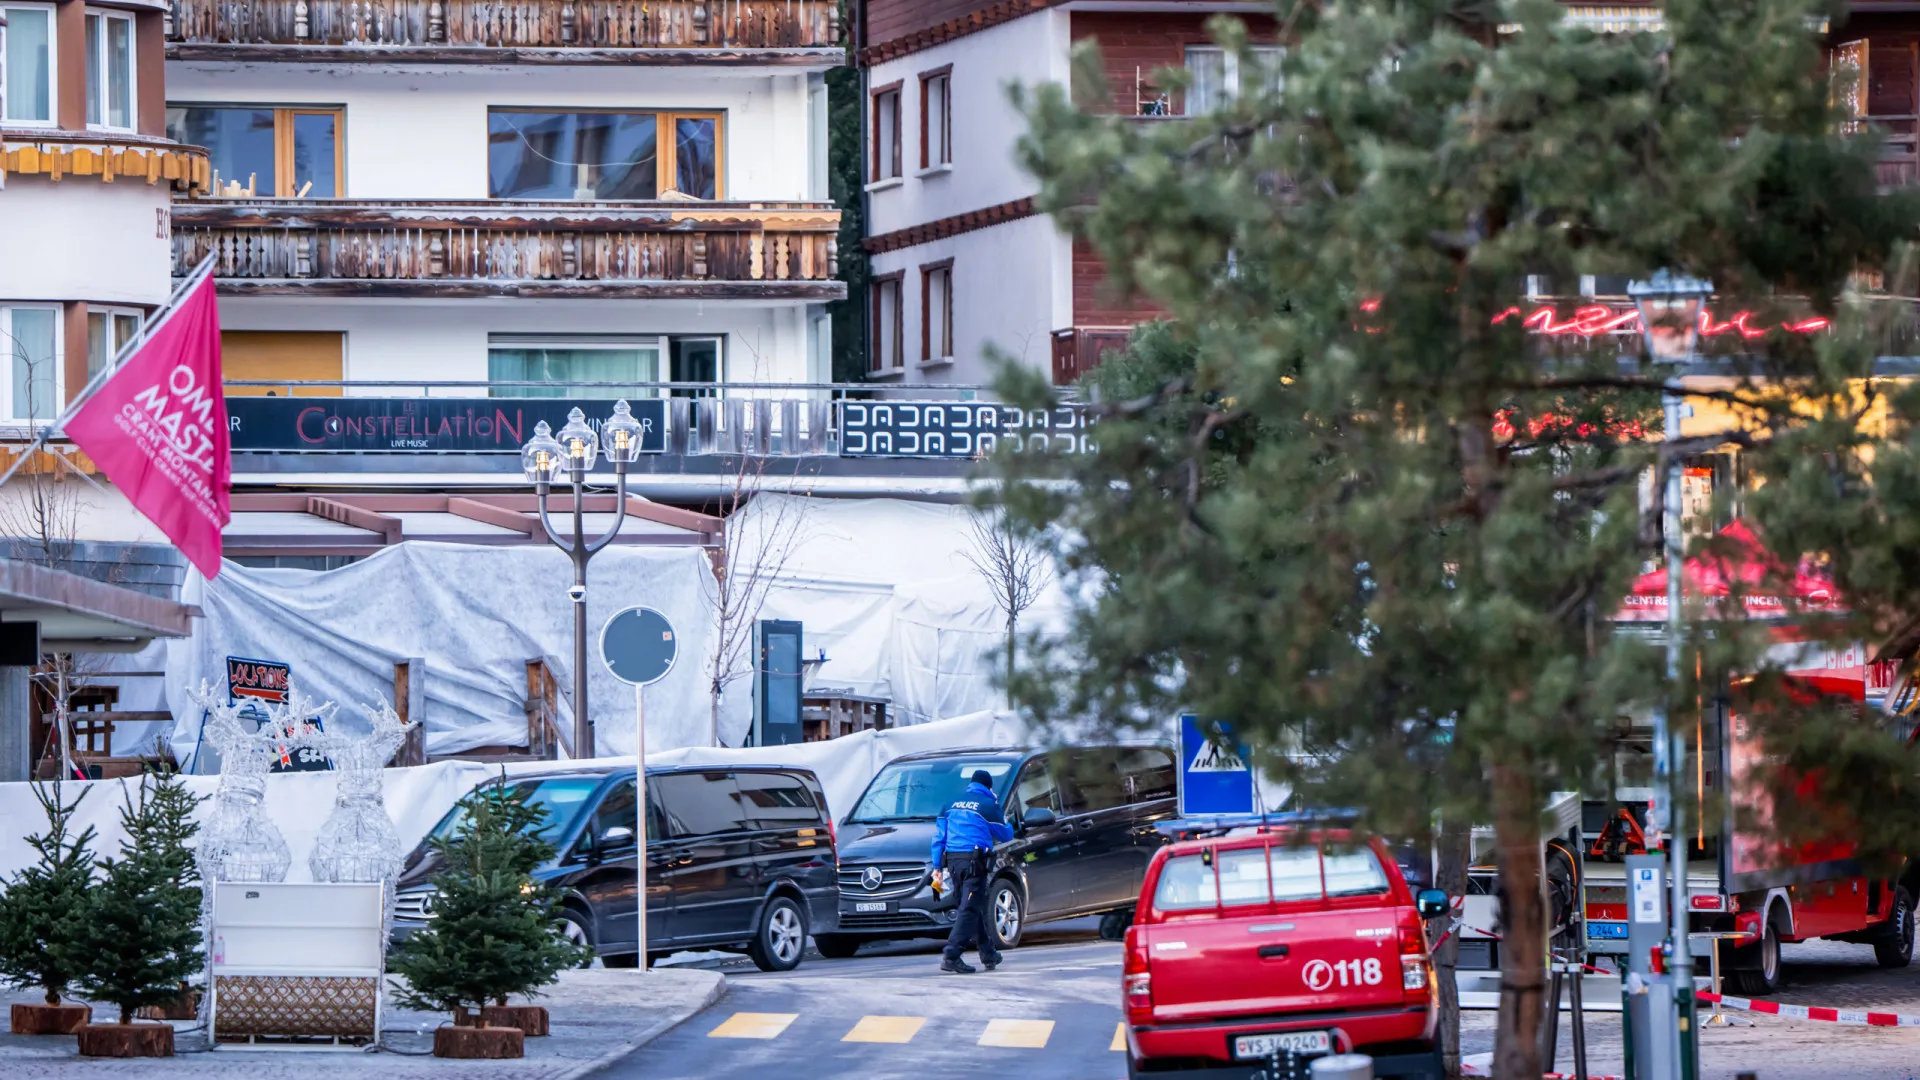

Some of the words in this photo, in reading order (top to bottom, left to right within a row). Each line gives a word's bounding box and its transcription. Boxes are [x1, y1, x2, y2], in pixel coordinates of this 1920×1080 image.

[391, 440, 406, 448] LIVE
[407, 440, 429, 448] MUSIC
[1624, 595, 1669, 606] CENTRE
[229, 662, 289, 690] LOCATIONS
[951, 800, 980, 811] POLICE
[1596, 924, 1613, 935] 244
[1333, 957, 1383, 986] 118
[1246, 1039, 1264, 1054] VS
